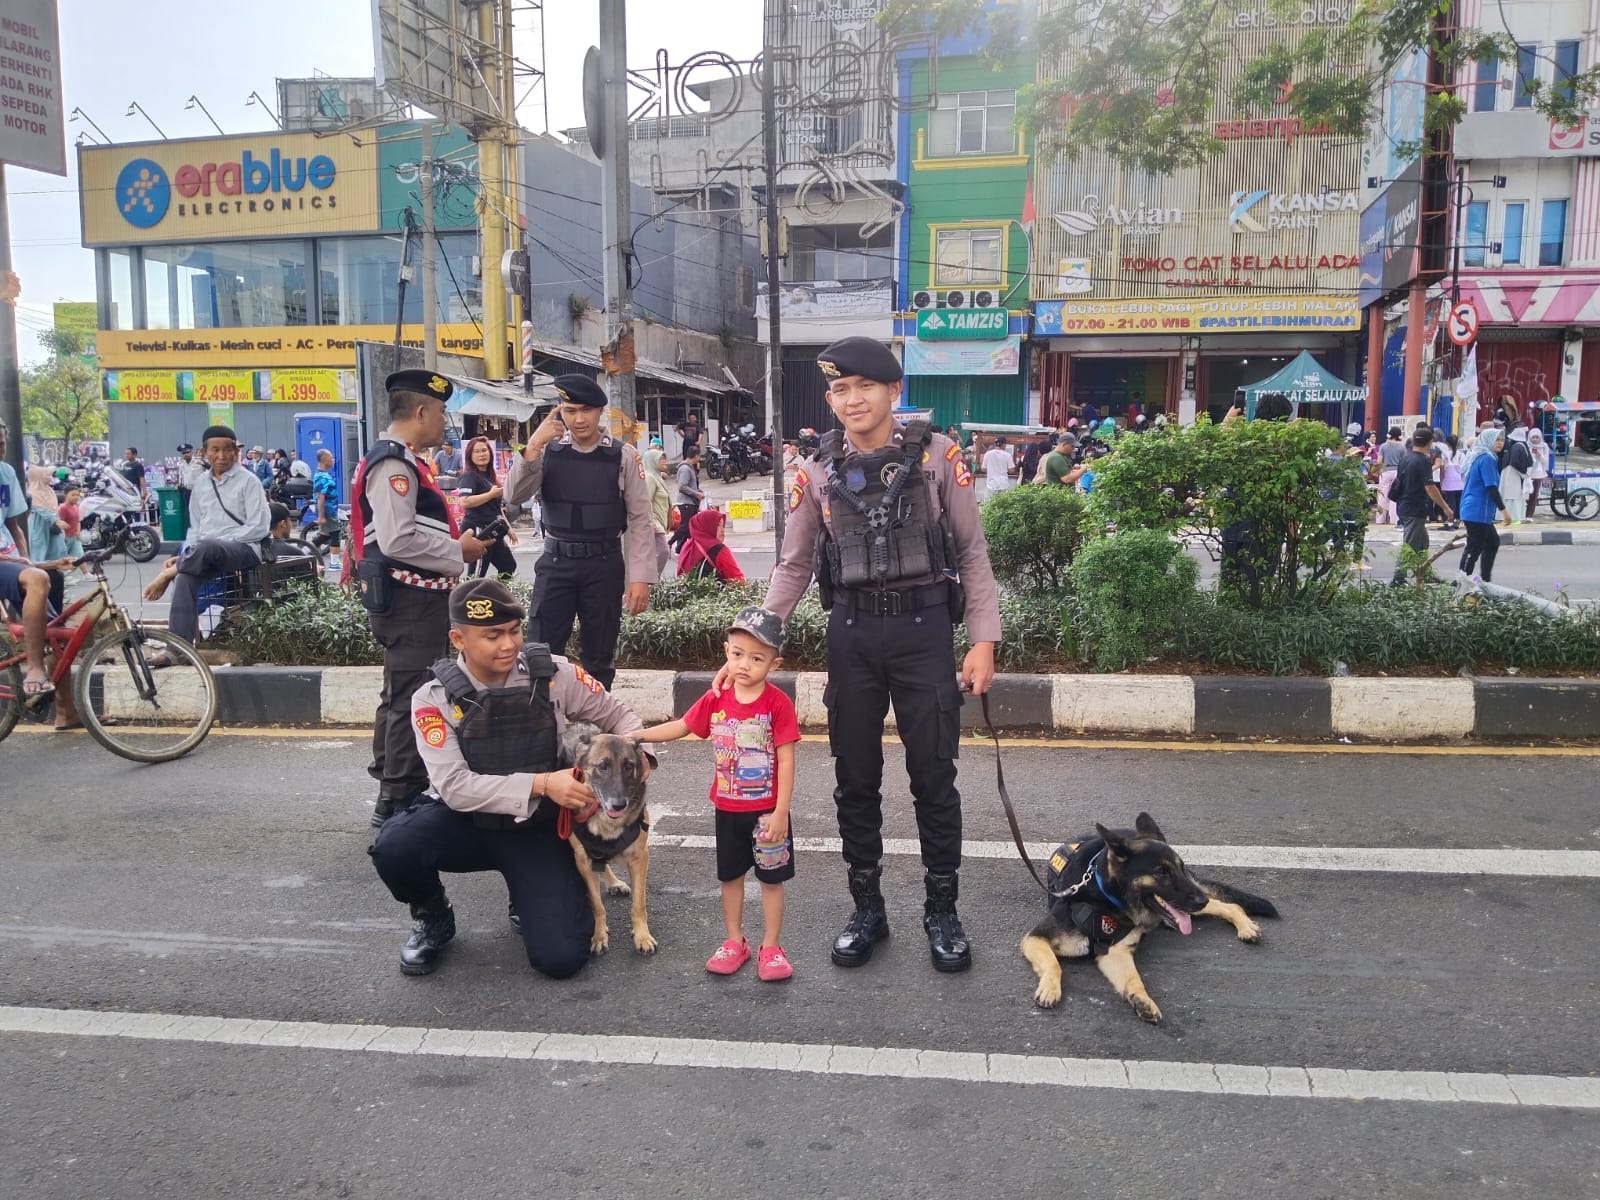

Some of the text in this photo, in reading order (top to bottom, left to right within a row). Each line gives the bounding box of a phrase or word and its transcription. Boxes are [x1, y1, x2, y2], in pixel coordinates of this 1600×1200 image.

[808, 8, 881, 21] BARBERPED
[2, 18, 39, 40] MOBIL
[28, 82, 53, 99] RHK
[2, 94, 48, 118] SEPEDA
[4, 114, 47, 136] MOTOR
[1215, 115, 1337, 147] asianp
[175, 148, 336, 198] erablue
[179, 195, 337, 216] ELECTRONICS
[1269, 192, 1359, 213] KANSA
[1101, 202, 1182, 226] Avian
[1269, 215, 1322, 231] PAINT
[1122, 254, 1360, 272] TOKO CAT SELALU ADA
[1068, 303, 1107, 314] BUKA
[1112, 303, 1153, 314] LEBIH
[1201, 302, 1249, 312] TUTUP
[1254, 301, 1297, 311] LEBIH
[1303, 301, 1356, 311] MALAM
[948, 312, 1004, 329] TAMZIS
[1067, 319, 1106, 330] 07.00
[1118, 318, 1157, 330] 21.00
[1162, 317, 1190, 329] WIB
[1200, 315, 1356, 328] #PASTILEBIHMURAH
[221, 339, 254, 350] Mesin
[257, 339, 281, 350] cuci
[296, 338, 313, 350] AC
[1305, 389, 1343, 401] SELALU
[1345, 389, 1367, 401] ADA
